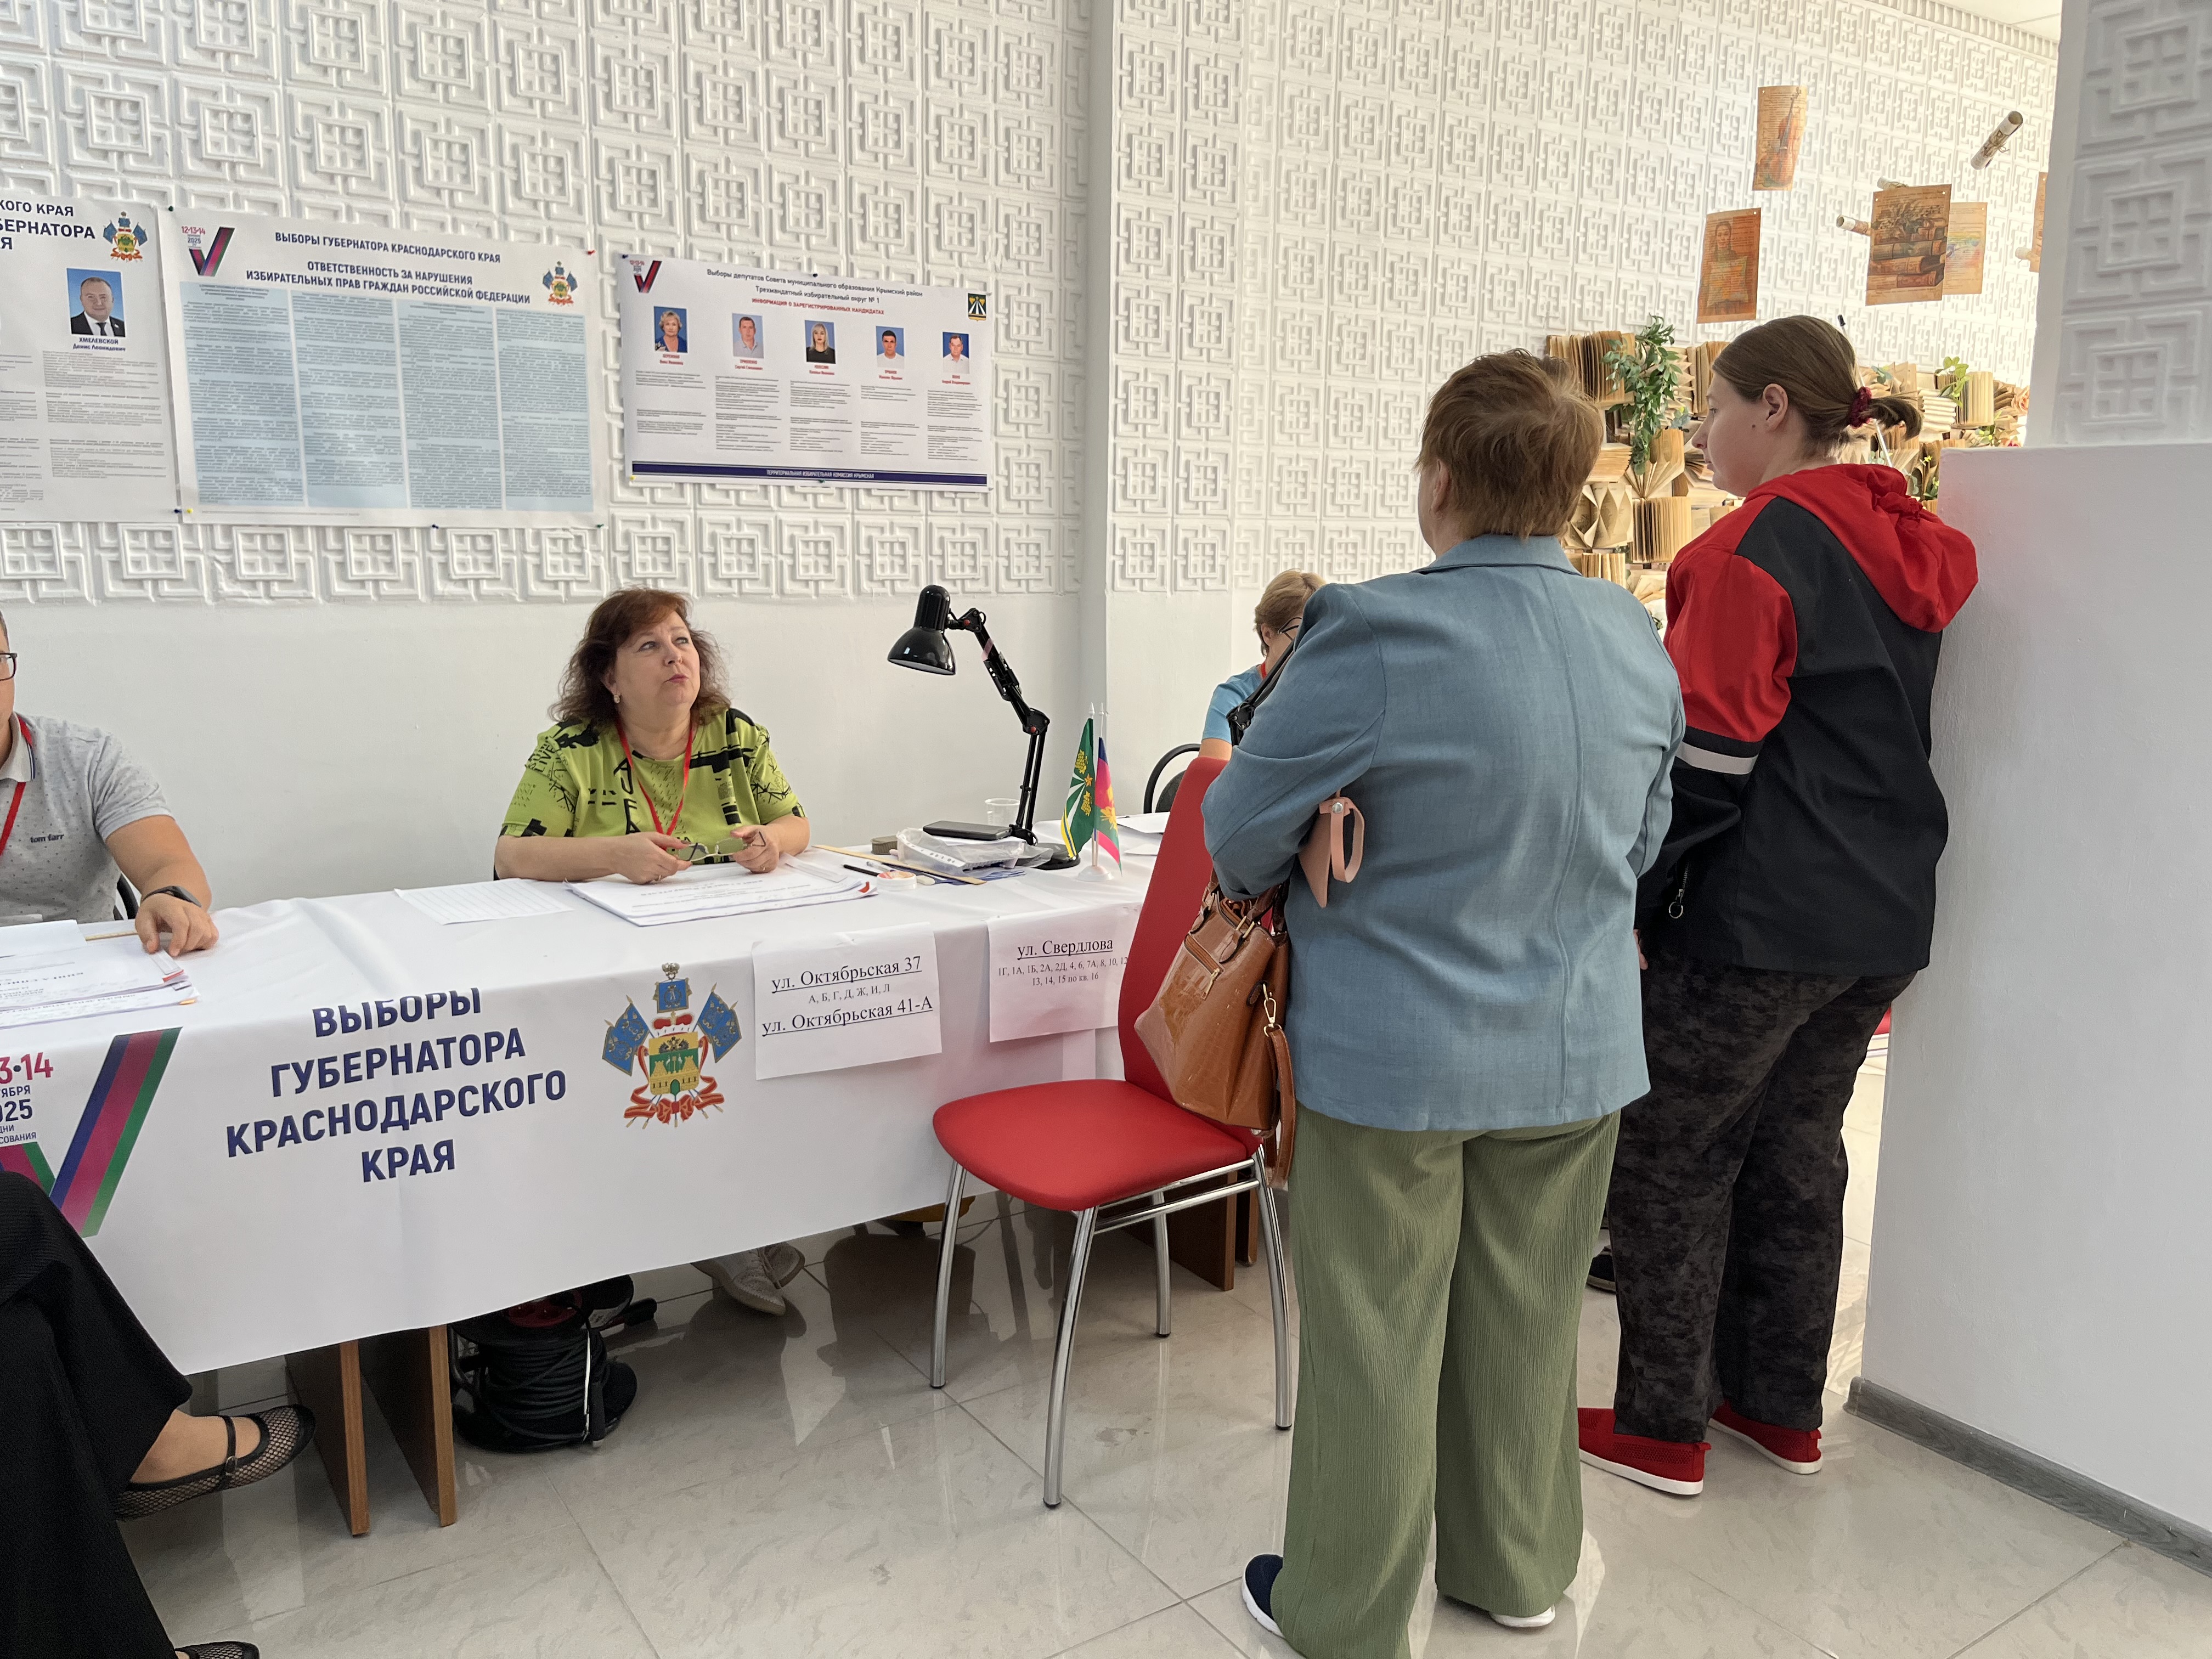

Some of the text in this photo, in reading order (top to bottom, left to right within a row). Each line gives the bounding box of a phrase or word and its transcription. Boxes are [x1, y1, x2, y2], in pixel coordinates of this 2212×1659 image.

[36, 204, 74, 217] КРАЯ
[275, 232, 501, 263] ВЫБОРЫ ГУБЕРНАТОРА КРАСНОДАРСКОГО КРАЯ
[307, 261, 473, 285] ОТВЕТСТВЕННОСТЬ ЗА НАРУШЕНИЯ
[707, 269, 732, 278] Выборы
[765, 275, 786, 284] Совета
[787, 279, 837, 289] муниципального
[838, 283, 875, 292] образования
[876, 286, 905, 295] Крымский
[906, 289, 923, 297] район
[246, 270, 531, 304] ИЗБИРАТЕЛЬНЫХ ПРАВ ГРАЖДАН РОССИЙСКОЙ ФЕДЕРАЦИИ
[755, 285, 803, 296] Трехмандатный
[804, 291, 850, 301] избирательный
[752, 298, 787, 306] ИНФОРМАЦИЯ
[793, 302, 851, 312] ЗАРЕГИСТРИРОВАННЫХ
[851, 307, 884, 315] КАНДИДАТАХ
[1017, 939, 1113, 960] ул. Свердлова
[771, 955, 921, 994] ул. Октябрьская 37
[998, 967, 1009, 977] 1Г,
[1012, 966, 1025, 974] 1А,
[1027, 965, 1039, 974] 1Б,
[1040, 964, 1053, 972] 2А,
[1055, 962, 1068, 972] 2Д,
[1069, 962, 1076, 970] 4,
[1078, 961, 1085, 969] 6,
[1100, 959, 1107, 968] 8,
[1109, 957, 1118, 966] 10,
[1032, 978, 1043, 986] 13,
[1045, 977, 1056, 985] 14,
[1058, 975, 1066, 983] 15
[1092, 972, 1099, 980] 16
[808, 984, 890, 1005] А, Б, Г, Д, Ж, И, Л
[312, 988, 481, 1038] ВЫБОРЫ
[761, 995, 933, 1036] ул. Октябрьская 41-А
[270, 1028, 527, 1098] ГУБЕРНАТОРА
[0, 1085, 31, 1098] ЯБРЯ
[226, 1070, 567, 1158] КРАСНОДАРСКОГО
[361, 1139, 455, 1183] КРАЯ
